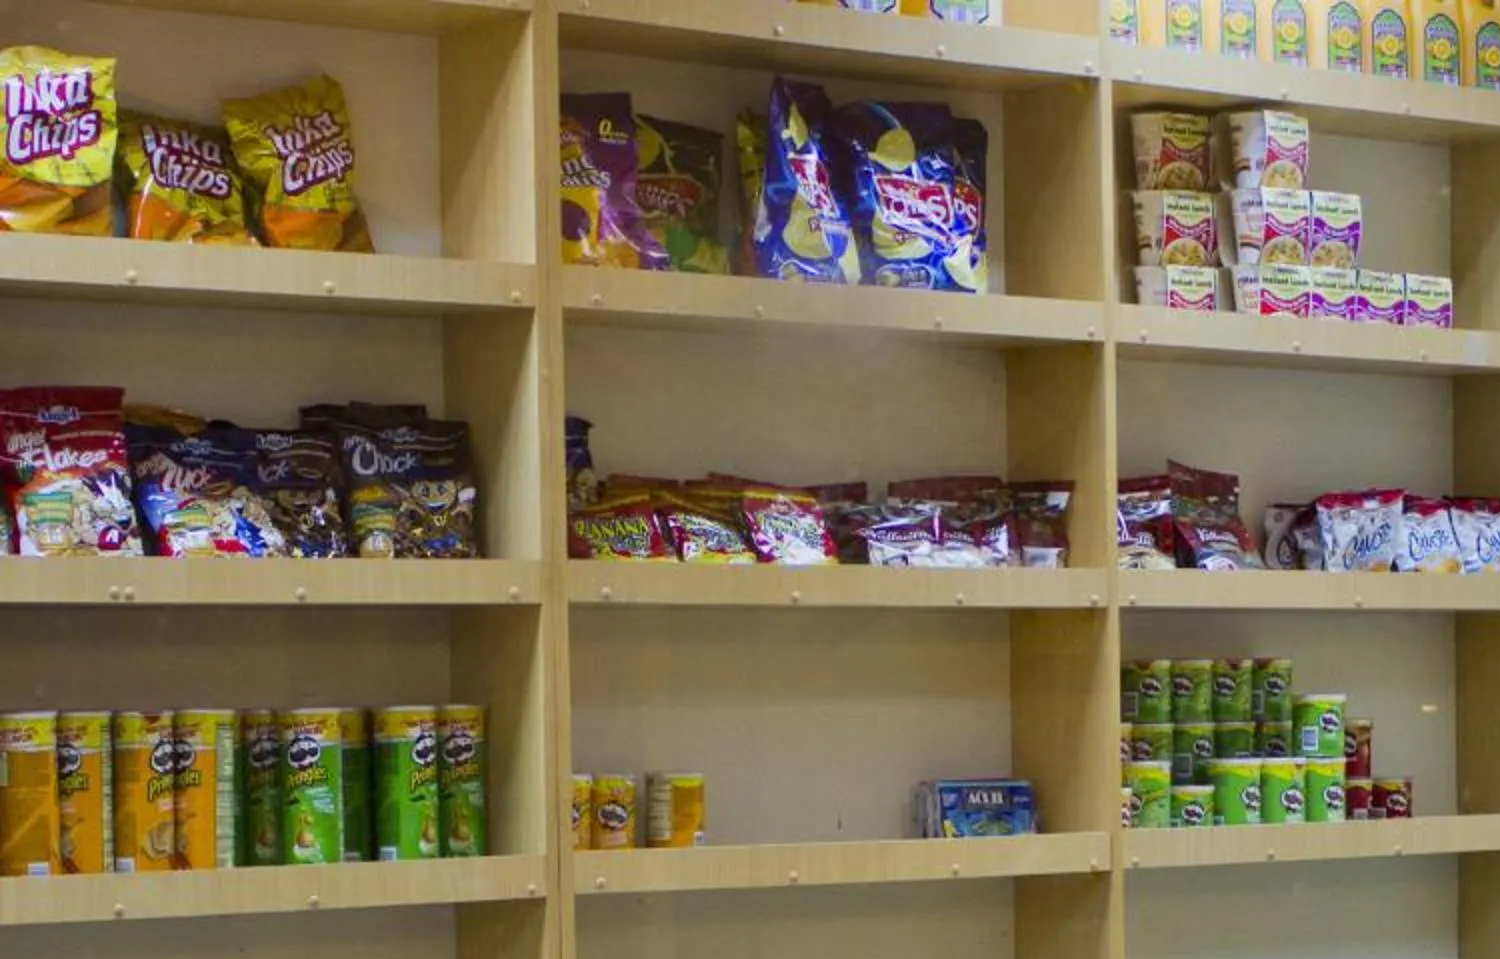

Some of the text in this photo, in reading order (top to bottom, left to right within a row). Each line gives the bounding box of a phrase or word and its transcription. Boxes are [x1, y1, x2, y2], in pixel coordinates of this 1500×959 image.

[3, 68, 92, 117] Inka
[8, 110, 99, 162] Chips
[143, 123, 222, 164] Inka
[268, 111, 342, 157] Inka
[151, 147, 231, 196] Chips
[282, 141, 354, 194] Chips
